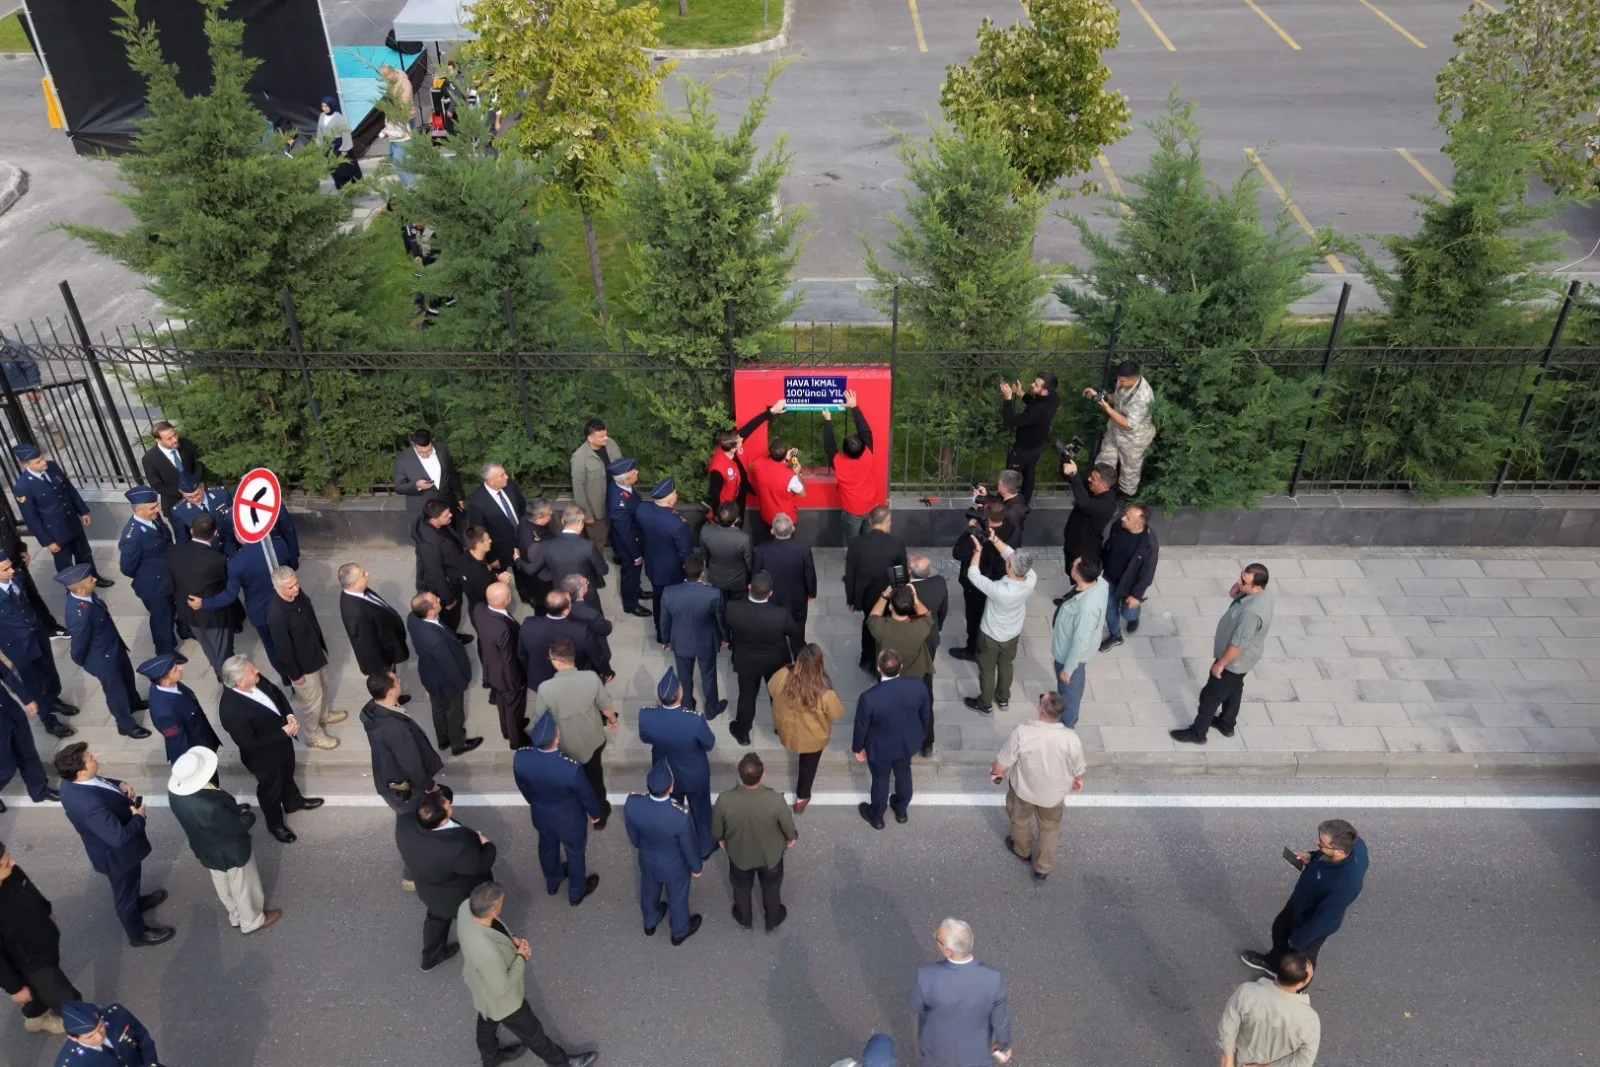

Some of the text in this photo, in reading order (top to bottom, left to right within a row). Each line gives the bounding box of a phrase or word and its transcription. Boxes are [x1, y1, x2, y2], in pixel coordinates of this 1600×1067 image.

[786, 378, 837, 387] HAVA İKMAL
[786, 389, 844, 397] 100'üncü YIL
